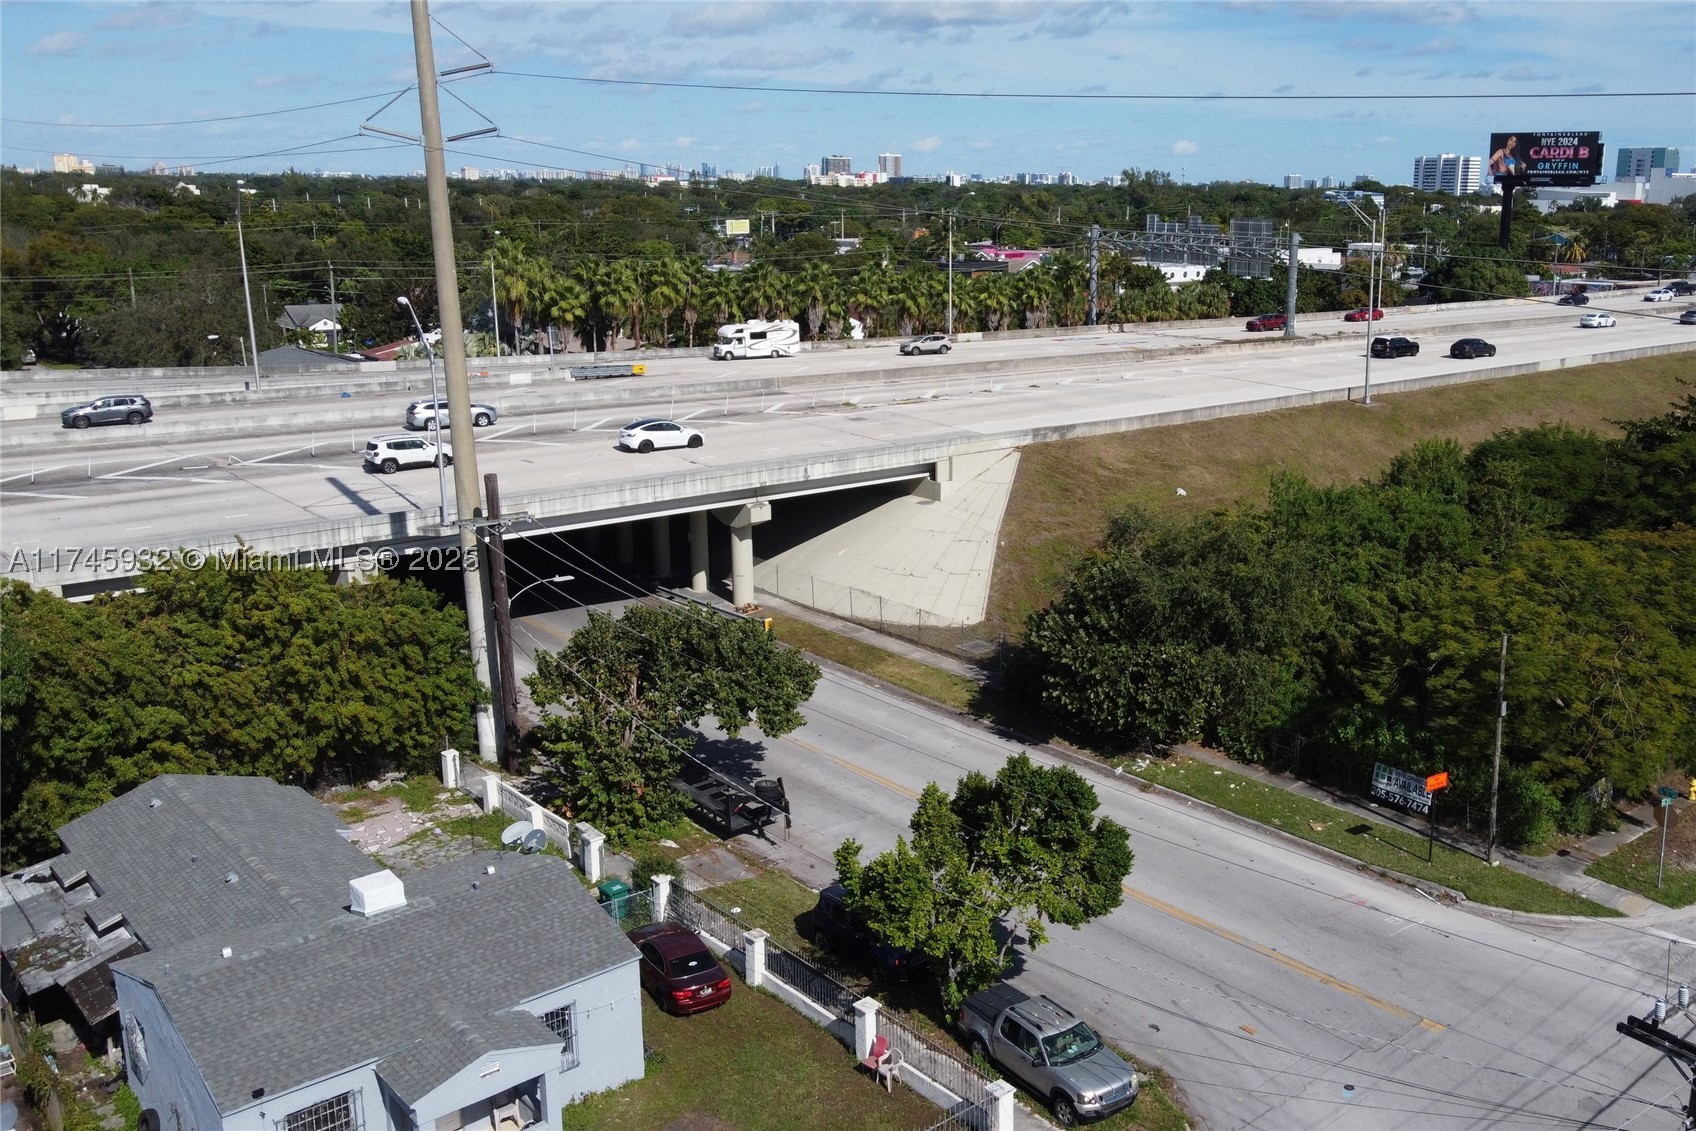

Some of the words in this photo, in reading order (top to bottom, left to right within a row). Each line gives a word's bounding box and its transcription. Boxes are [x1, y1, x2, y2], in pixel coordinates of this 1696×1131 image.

[1541, 137, 1556, 146] NYE
[1558, 137, 1578, 146] 2024
[1530, 146, 1574, 158] CARDI
[1578, 146, 1589, 158] B
[1537, 162, 1579, 170] GRYFFIN
[1371, 786, 1429, 814] 305-576-7474
